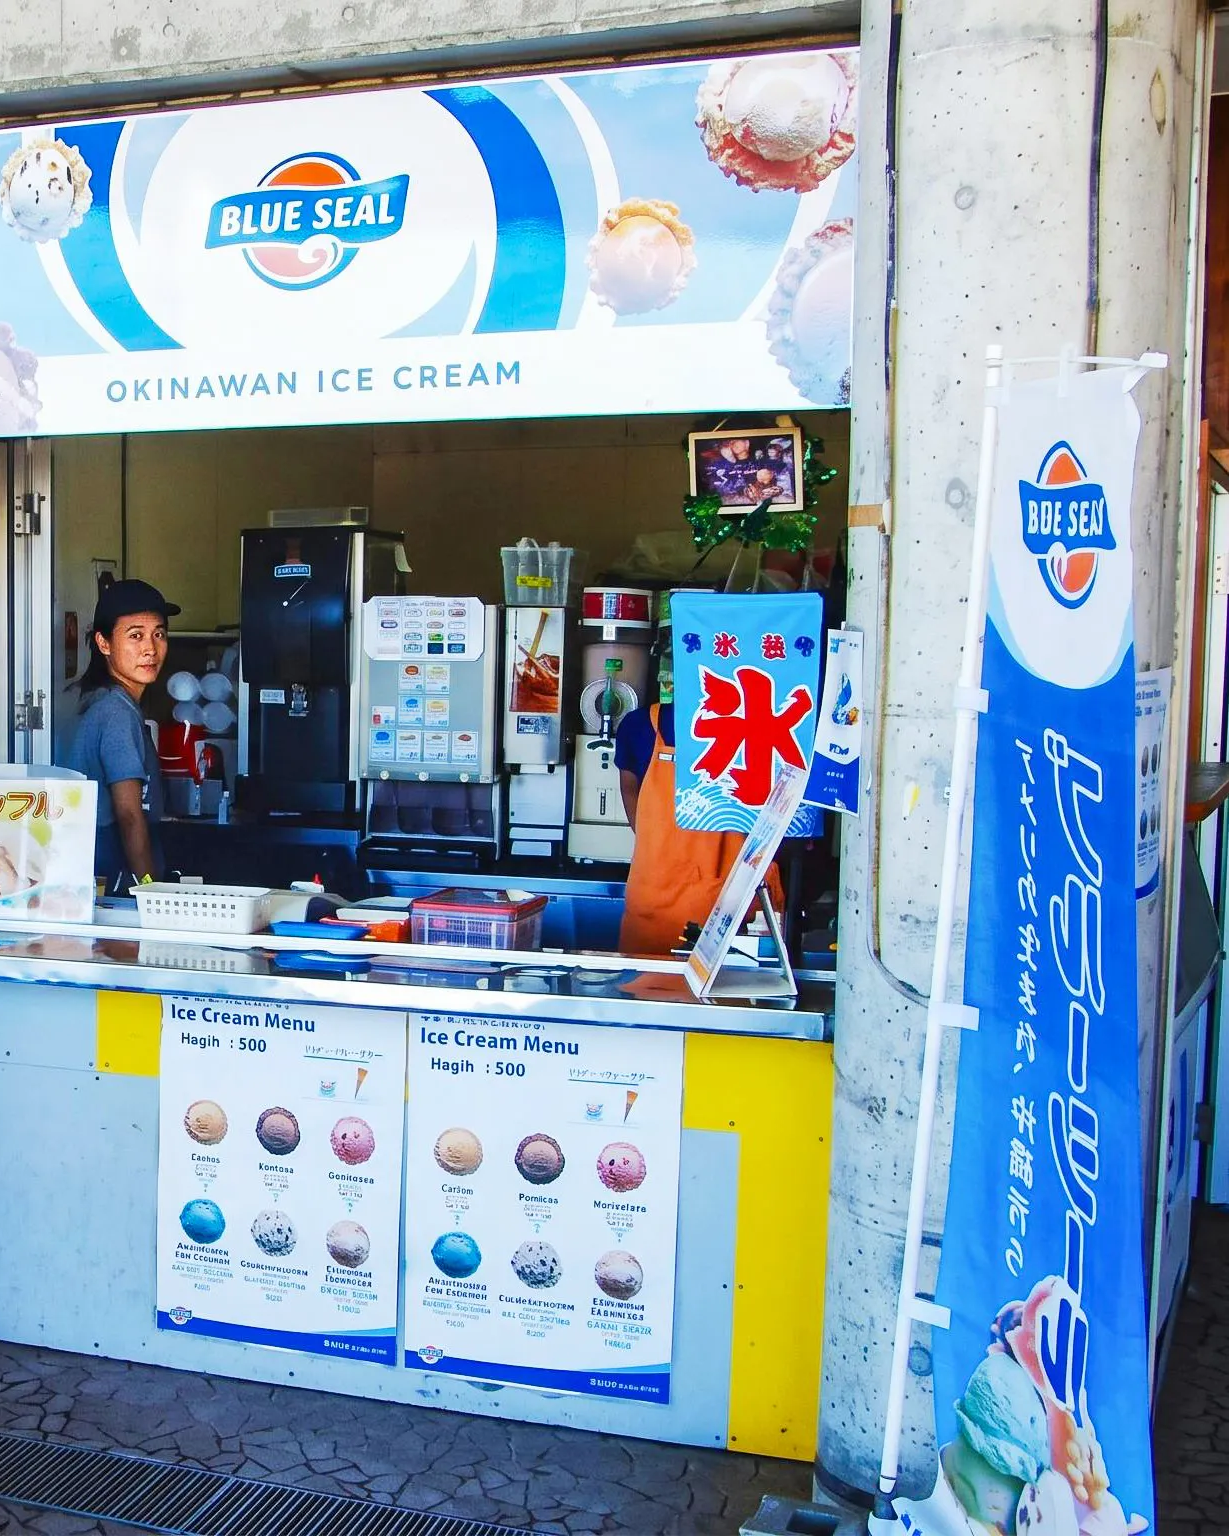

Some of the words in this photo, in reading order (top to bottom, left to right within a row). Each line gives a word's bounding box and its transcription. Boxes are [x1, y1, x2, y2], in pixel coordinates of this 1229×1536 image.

[220, 200, 303, 237] BLUE
[312, 193, 395, 229] SEAL
[107, 371, 297, 402] OKINAWAN
[318, 368, 373, 393] ICE
[393, 361, 521, 390] CREAM
[692, 666, 813, 807] 氷
[171, 1004, 197, 1021] Ice
[202, 1007, 259, 1027] Cream
[265, 1013, 315, 1033] Menu
[181, 1033, 220, 1049] Hagih
[421, 1027, 449, 1045] Ice
[454, 1030, 517, 1050] Cream
[524, 1035, 579, 1055] Menu
[431, 1057, 474, 1075] Hagih
